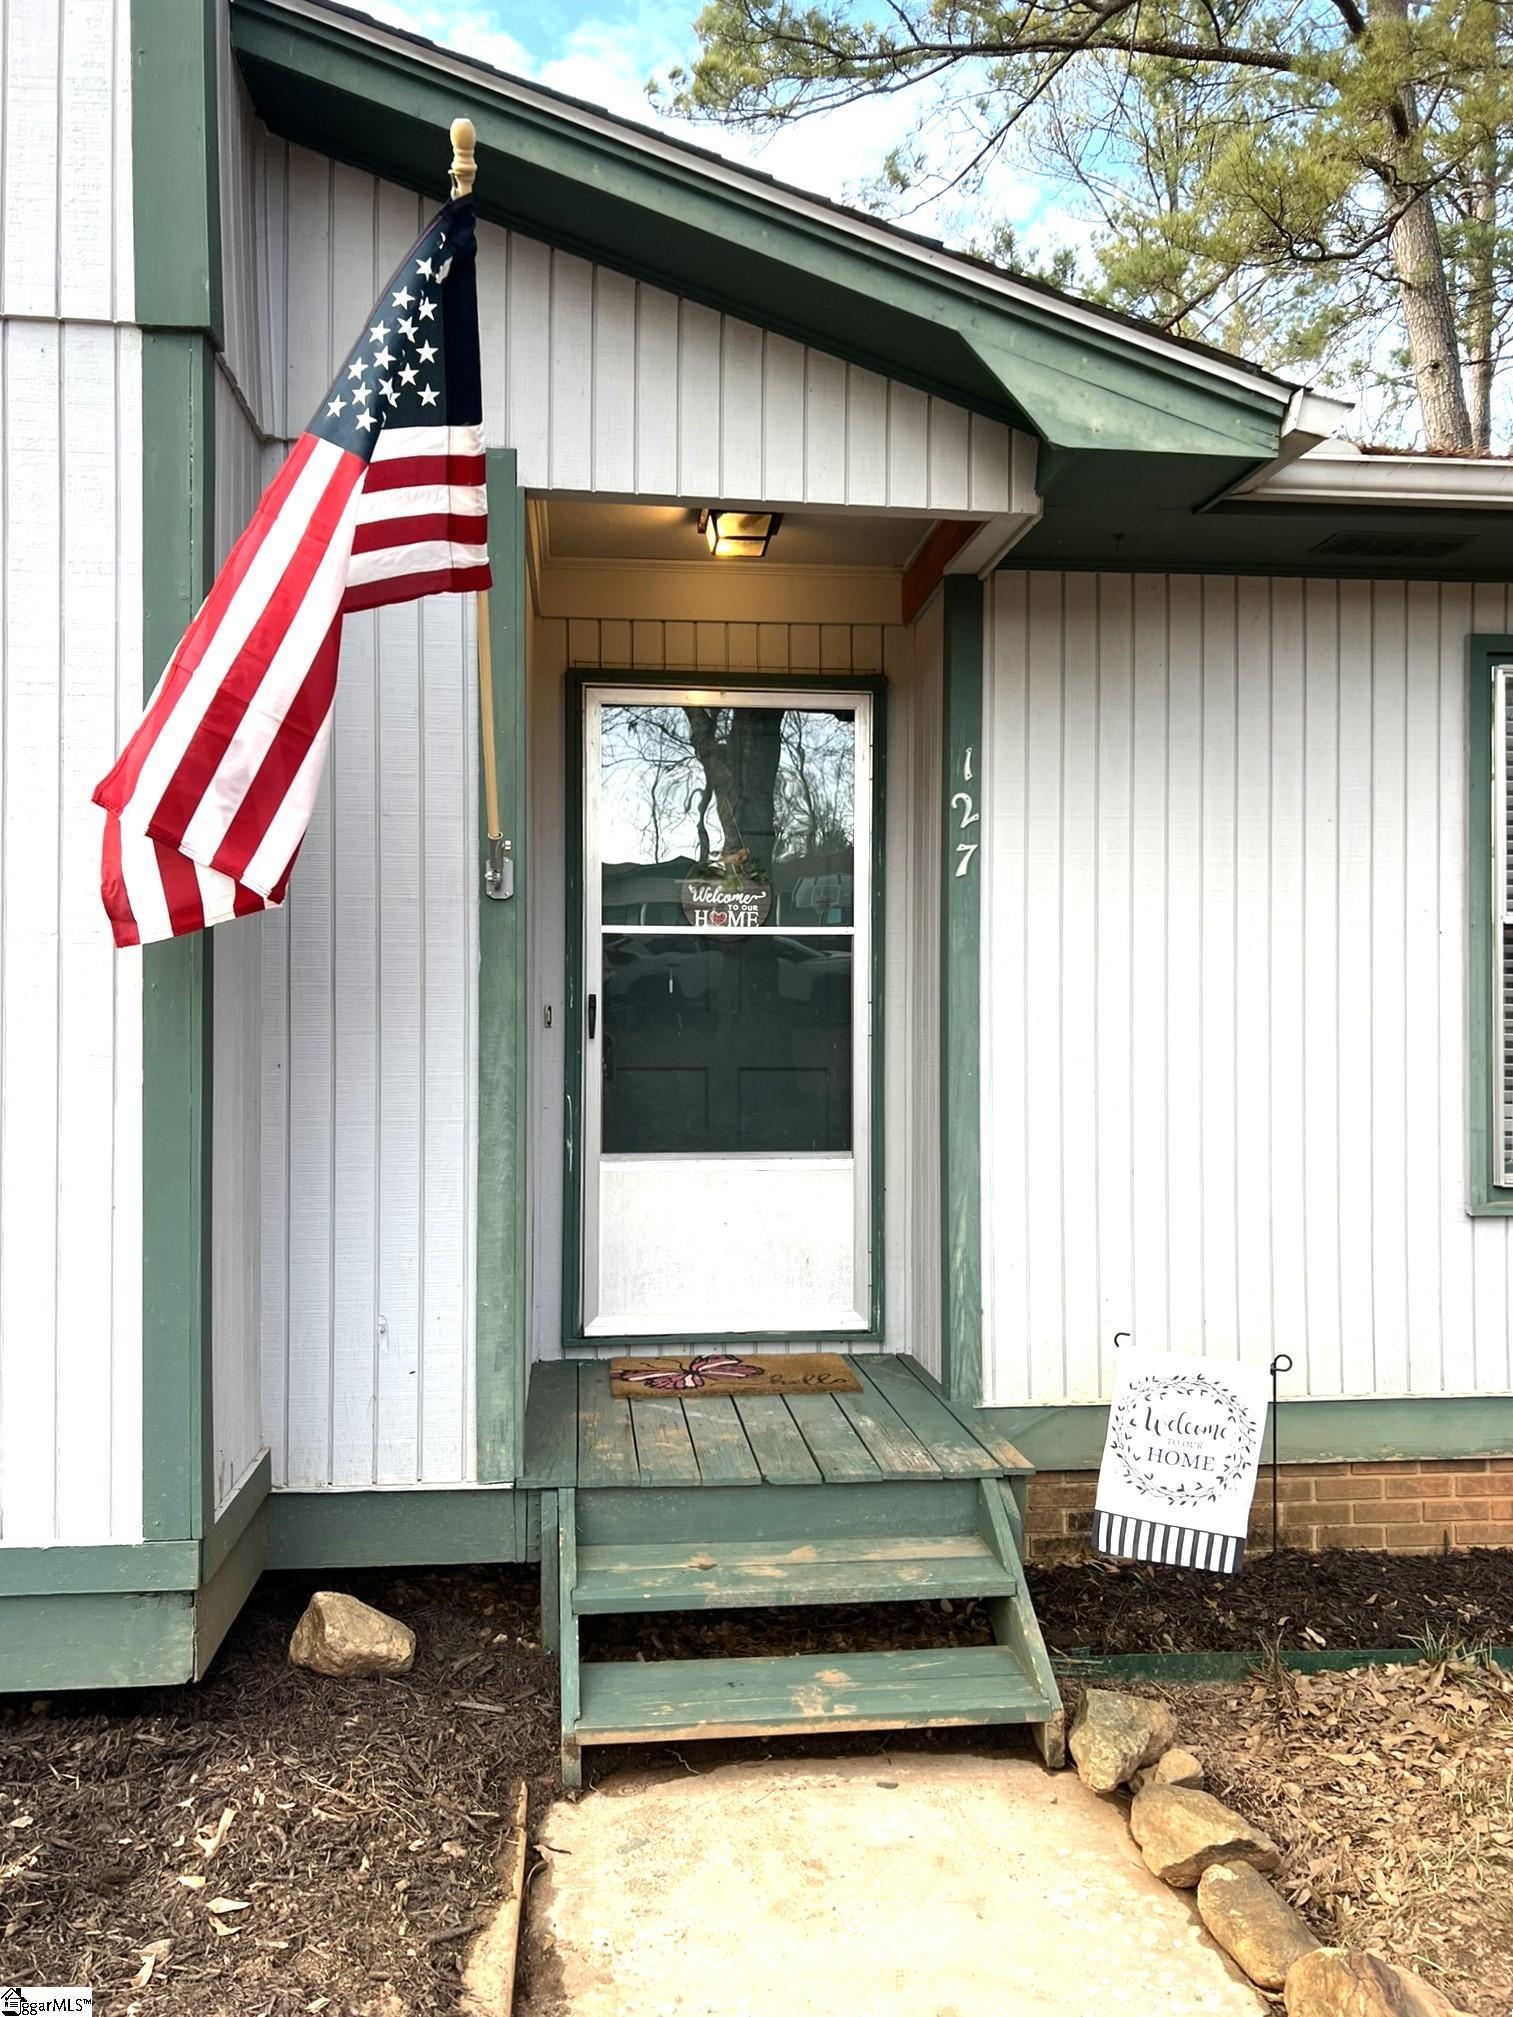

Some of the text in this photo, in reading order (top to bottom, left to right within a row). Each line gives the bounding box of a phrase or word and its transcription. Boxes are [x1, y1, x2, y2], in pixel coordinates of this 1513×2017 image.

[688, 884, 767, 904] Welcome
[741, 904, 759, 912] OUR
[1144, 1407, 1227, 1440] Welcome
[1147, 1446, 1215, 1472] HOME
